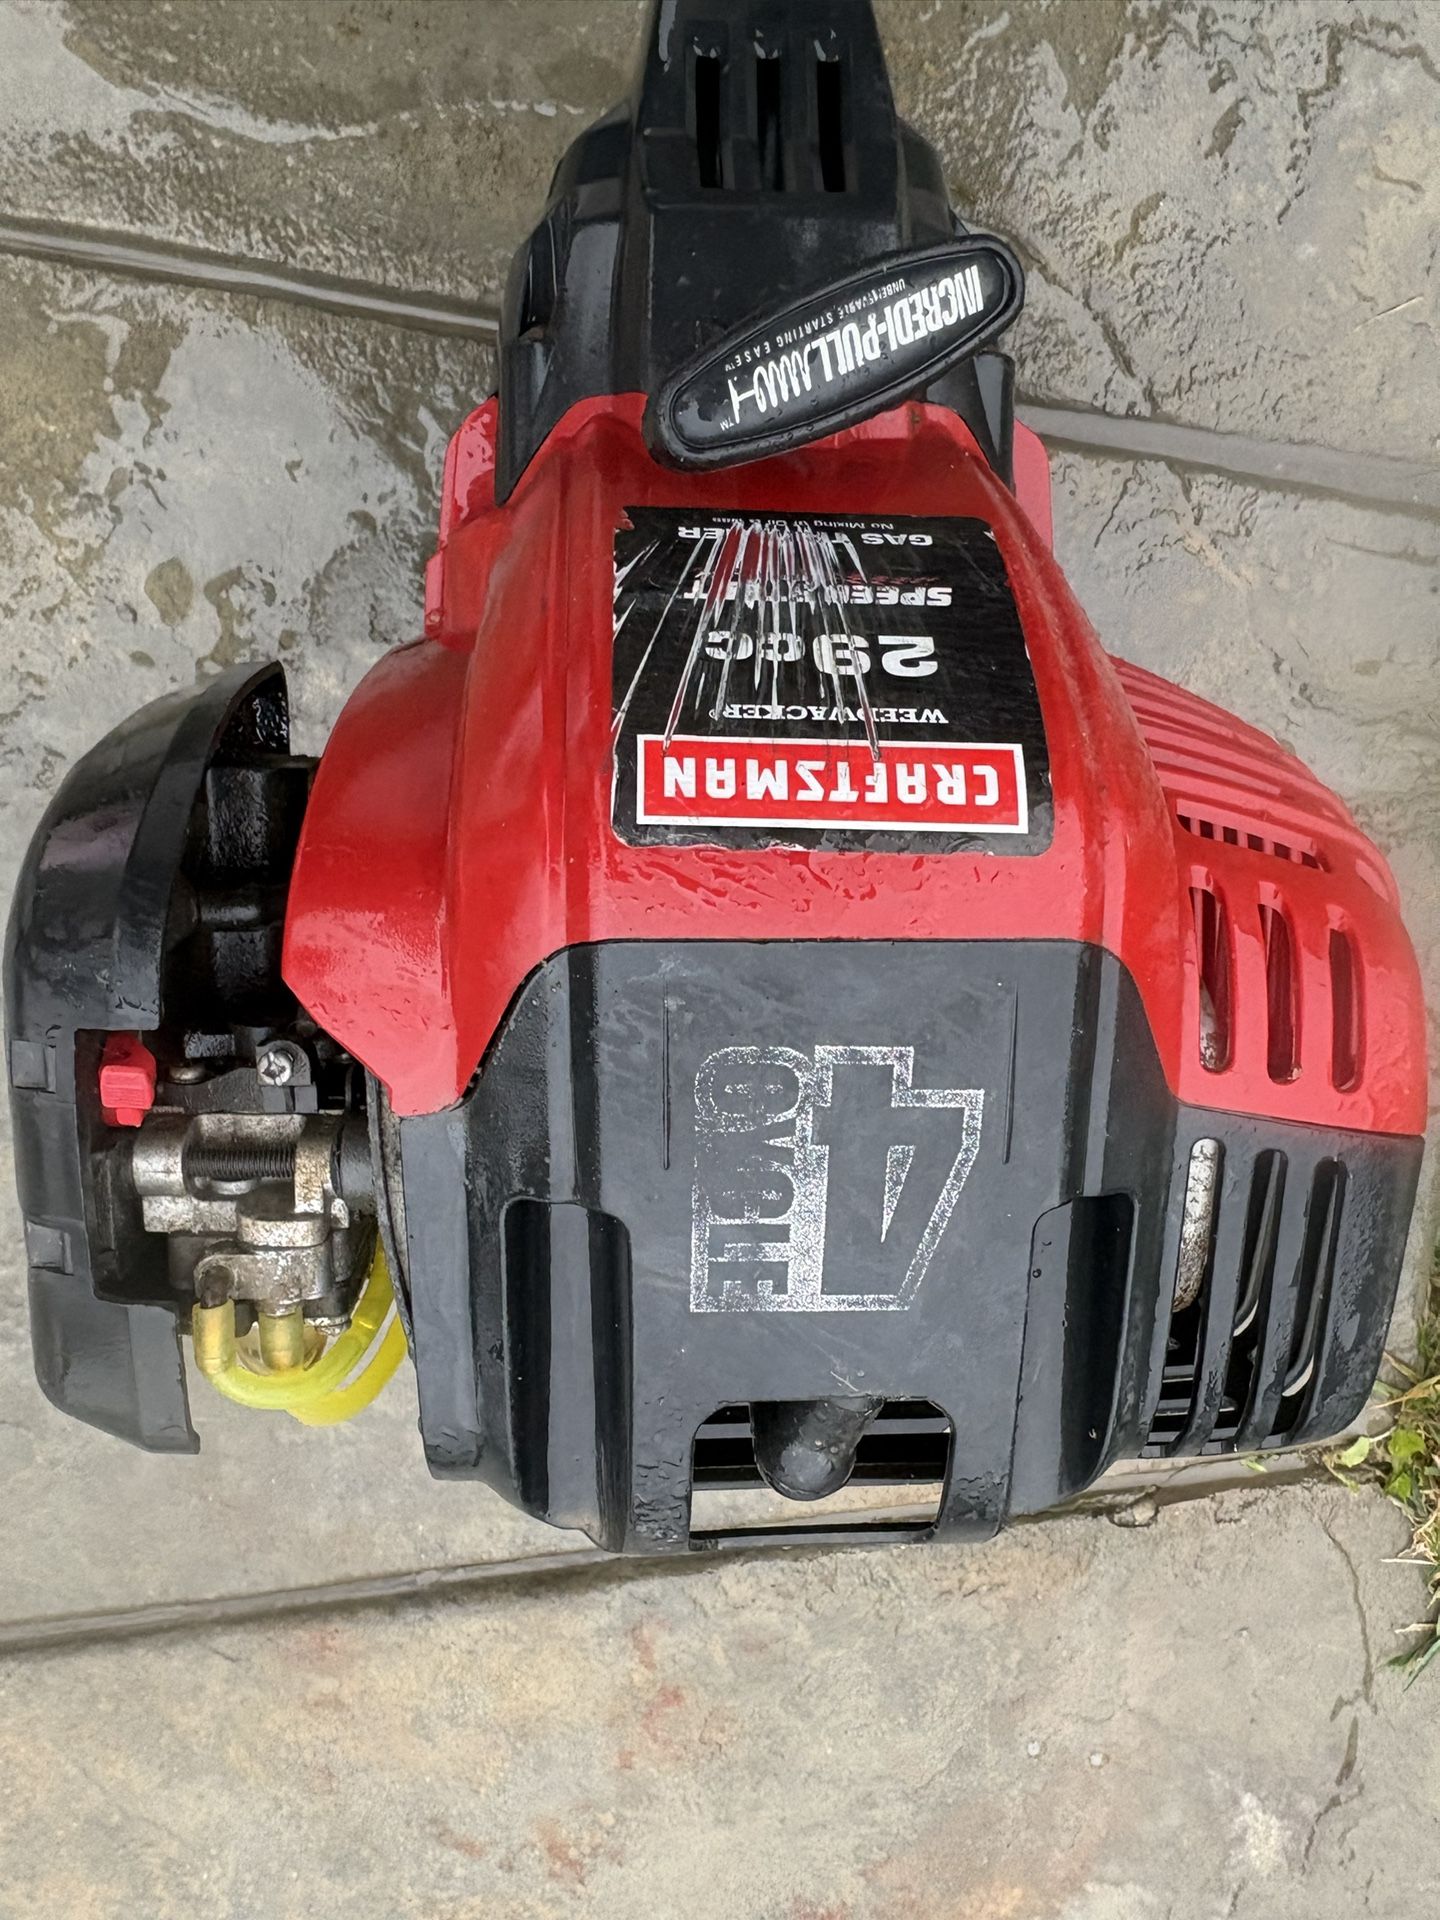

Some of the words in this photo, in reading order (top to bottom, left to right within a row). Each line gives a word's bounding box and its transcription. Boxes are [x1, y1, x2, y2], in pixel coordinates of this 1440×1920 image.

[776, 312, 834, 348] STARTING
[814, 520, 865, 530] Mixing
[861, 533, 933, 547] GAS
[662, 756, 1000, 806] CRAFTSMAN
